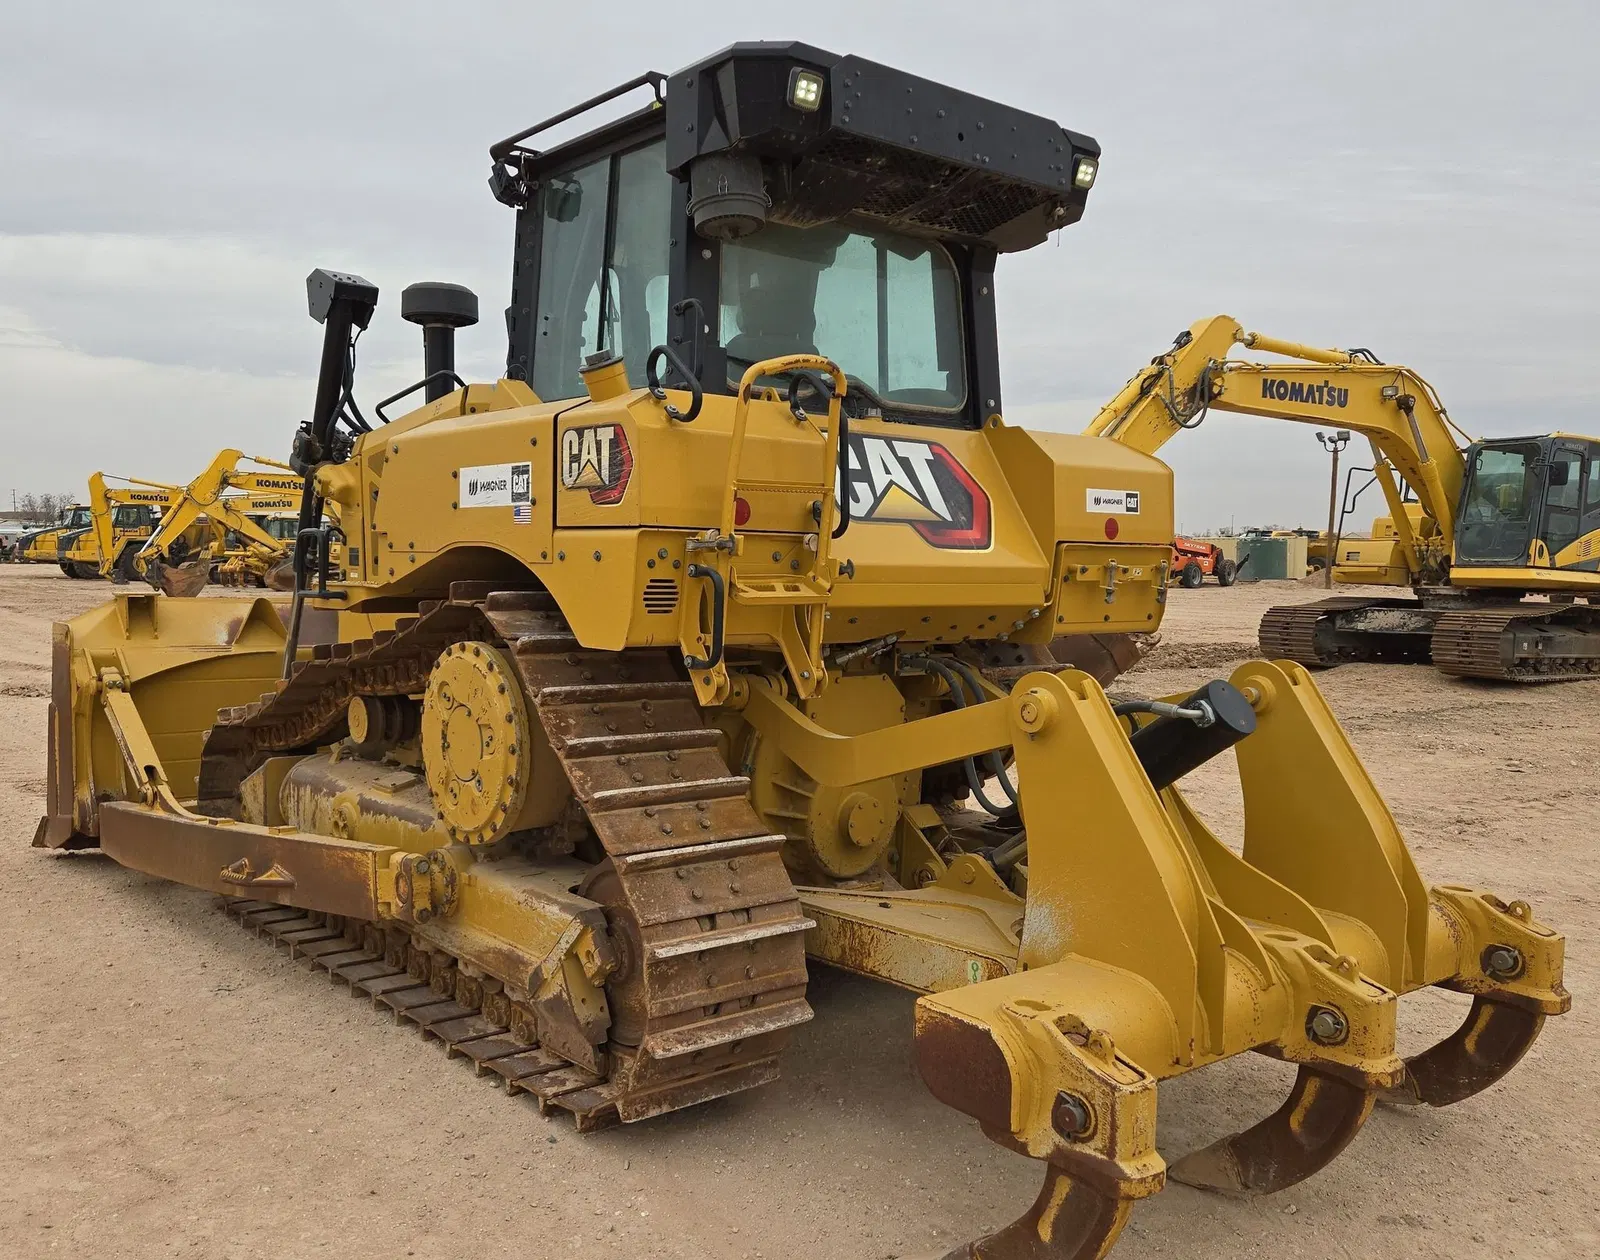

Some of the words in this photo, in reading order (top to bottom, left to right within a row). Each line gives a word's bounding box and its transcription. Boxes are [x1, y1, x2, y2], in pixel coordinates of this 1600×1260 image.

[1262, 378, 1348, 408] KOMATSU
[563, 427, 614, 487] CAT
[256, 479, 305, 491] KOMATSU
[480, 480, 508, 492] WAGNER
[513, 474, 529, 493] CAT
[130, 493, 169, 502] KOMATSU
[252, 499, 292, 508] KOMATSU
[1102, 498, 1123, 506] WAGNER
[1126, 497, 1138, 508] CAT
